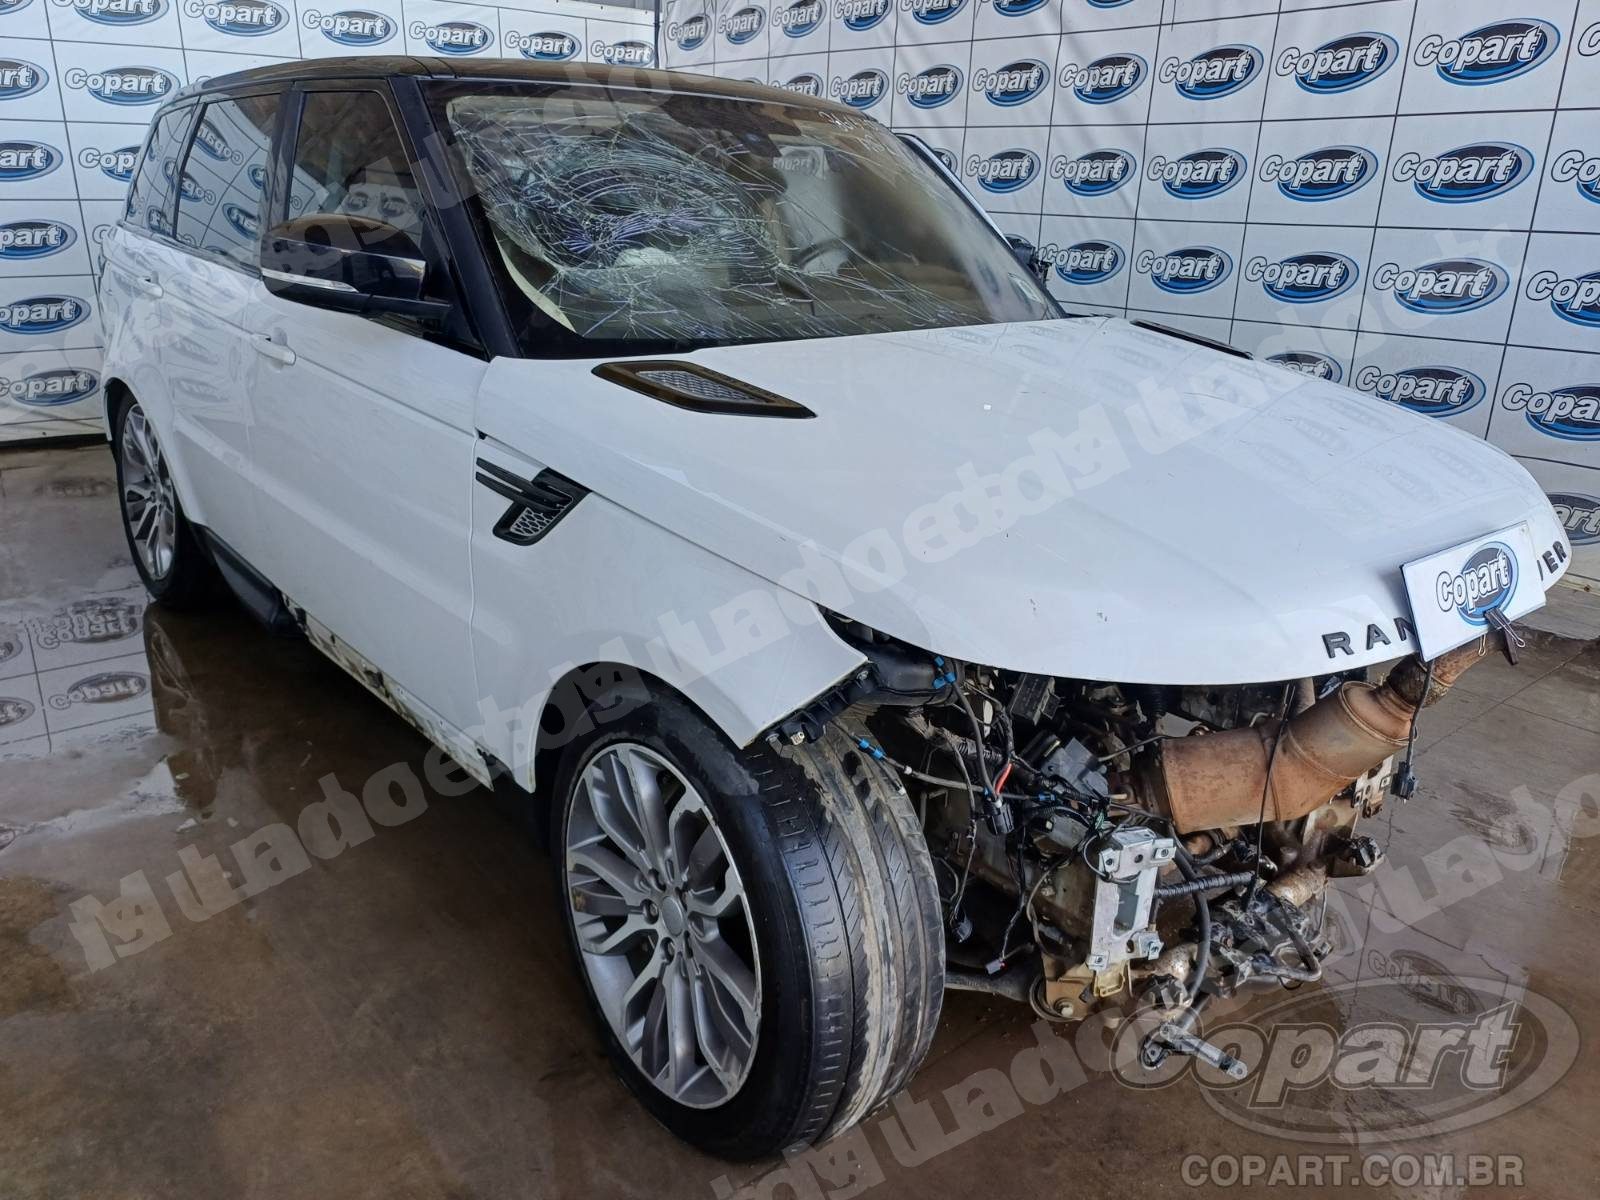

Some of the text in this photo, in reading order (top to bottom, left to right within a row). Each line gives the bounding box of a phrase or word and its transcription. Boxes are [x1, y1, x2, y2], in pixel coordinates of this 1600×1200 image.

[184, 0, 277, 27] Copart
[303, 9, 385, 38] Copart
[717, 13, 760, 38] Copart
[772, 3, 819, 28] Copart
[834, 0, 886, 23] Copart
[409, 20, 484, 47] Copart
[504, 31, 572, 57] Copart
[668, 21, 706, 45] Copart
[591, 40, 651, 64] Copart
[1276, 39, 1383, 82] Copart
[1414, 24, 1543, 73] Copart
[65, 68, 166, 96] Copart
[897, 70, 954, 99] Copart
[973, 65, 1041, 97] Copart
[1059, 60, 1138, 94] Copart
[1160, 50, 1252, 89] Copart
[831, 74, 880, 102] Copart
[0, 145, 47, 170] art
[79, 148, 136, 175] Cop
[965, 153, 1032, 183] Copart
[1050, 154, 1125, 186] Copart
[1147, 154, 1236, 189] Copart
[1259, 150, 1364, 190] Copart
[1392, 149, 1518, 190] Copart
[0, 225, 61, 252] part
[1043, 243, 1114, 273] Copart
[1136, 249, 1222, 281] Copart
[1245, 256, 1344, 290] Copart
[1373, 262, 1492, 300] Copart
[1526, 270, 1600, 312] Cop
[0, 299, 76, 328] opart
[1355, 365, 1470, 406] Copart
[1501, 383, 1600, 425] Copa
[1436, 548, 1510, 614] Copart
[1321, 616, 1416, 660] RAN
